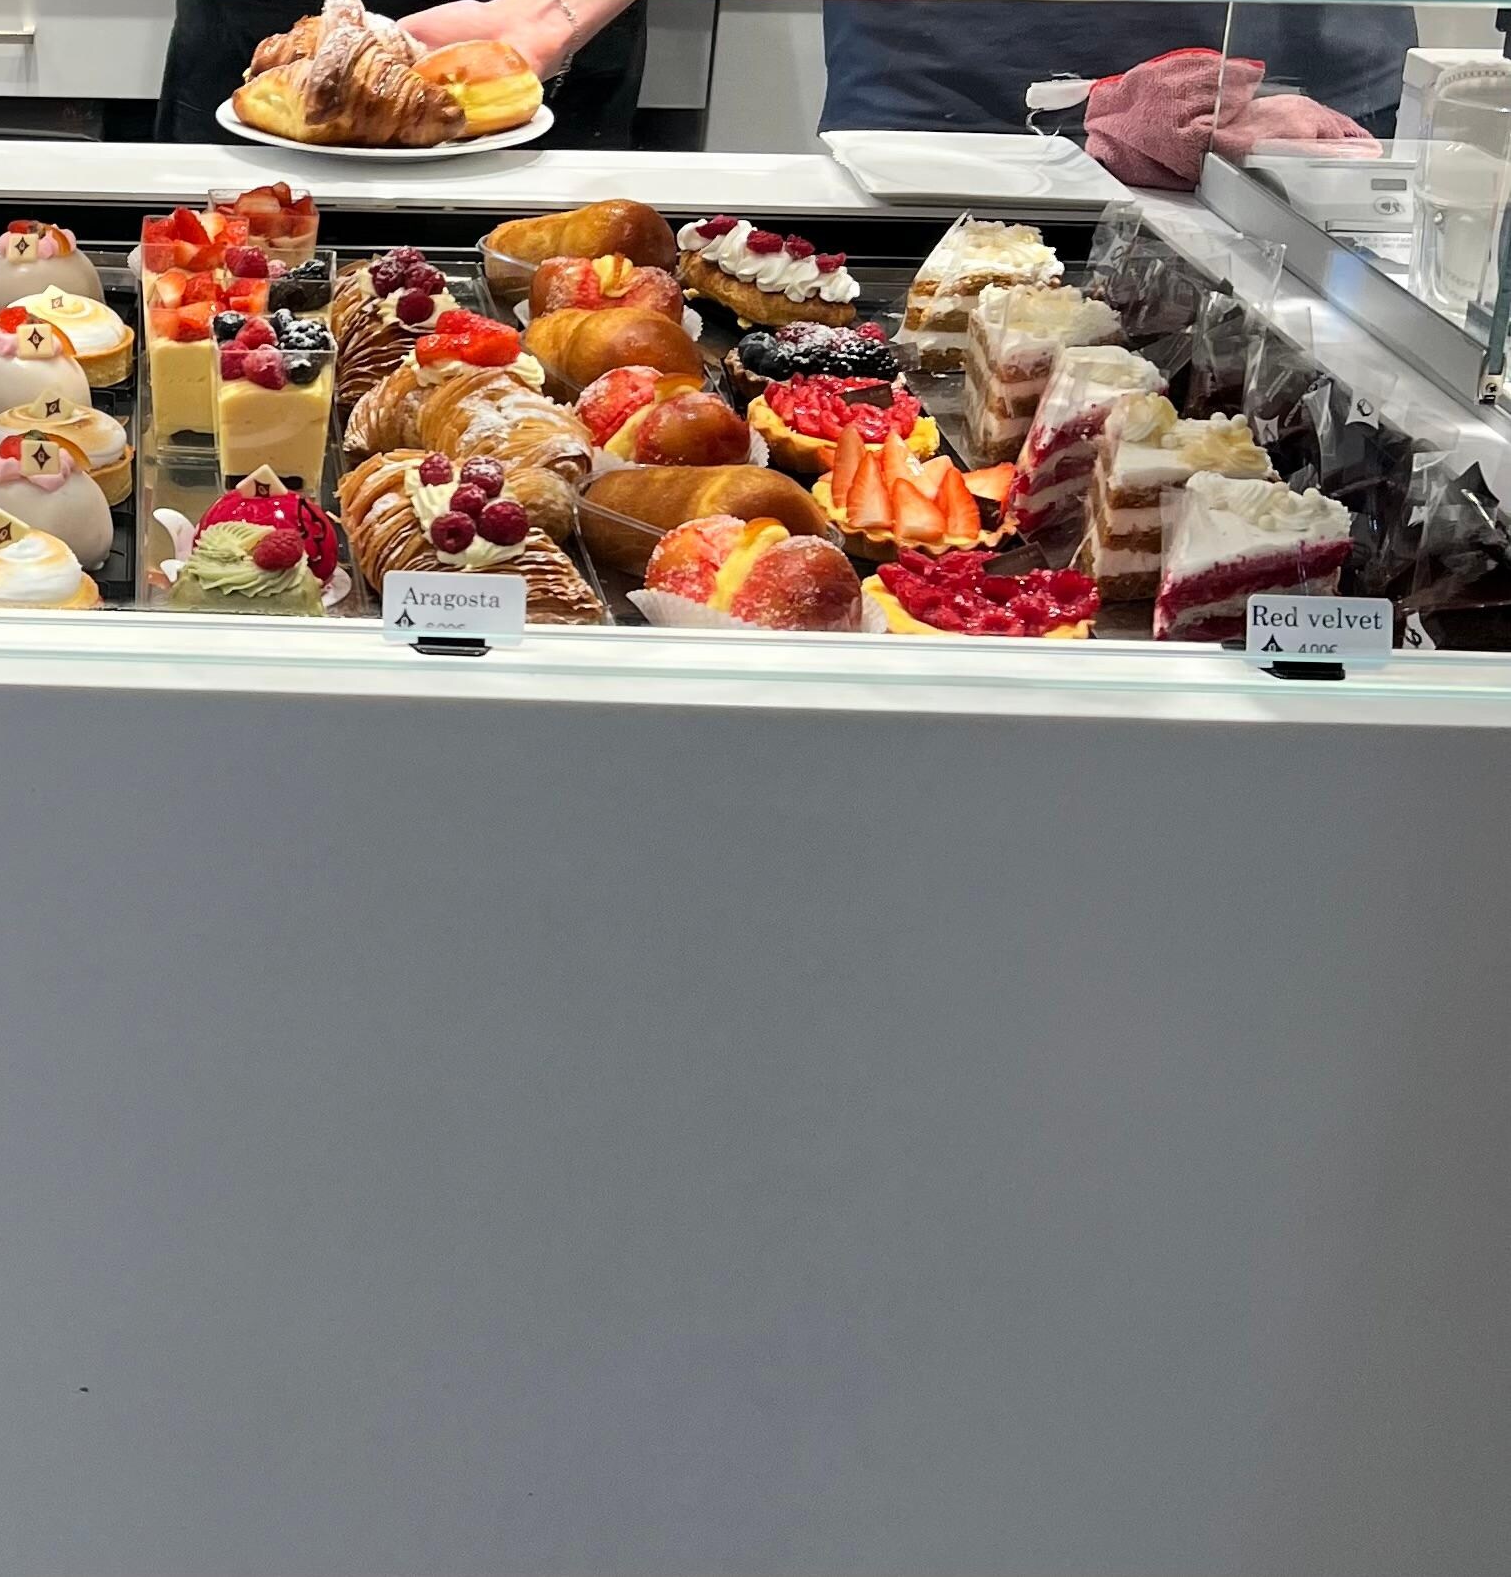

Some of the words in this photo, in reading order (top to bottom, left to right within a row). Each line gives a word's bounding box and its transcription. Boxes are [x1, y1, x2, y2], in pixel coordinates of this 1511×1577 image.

[401, 586, 501, 611] Aragosta
[1252, 605, 1300, 628] Red
[1307, 607, 1383, 630] velvet
